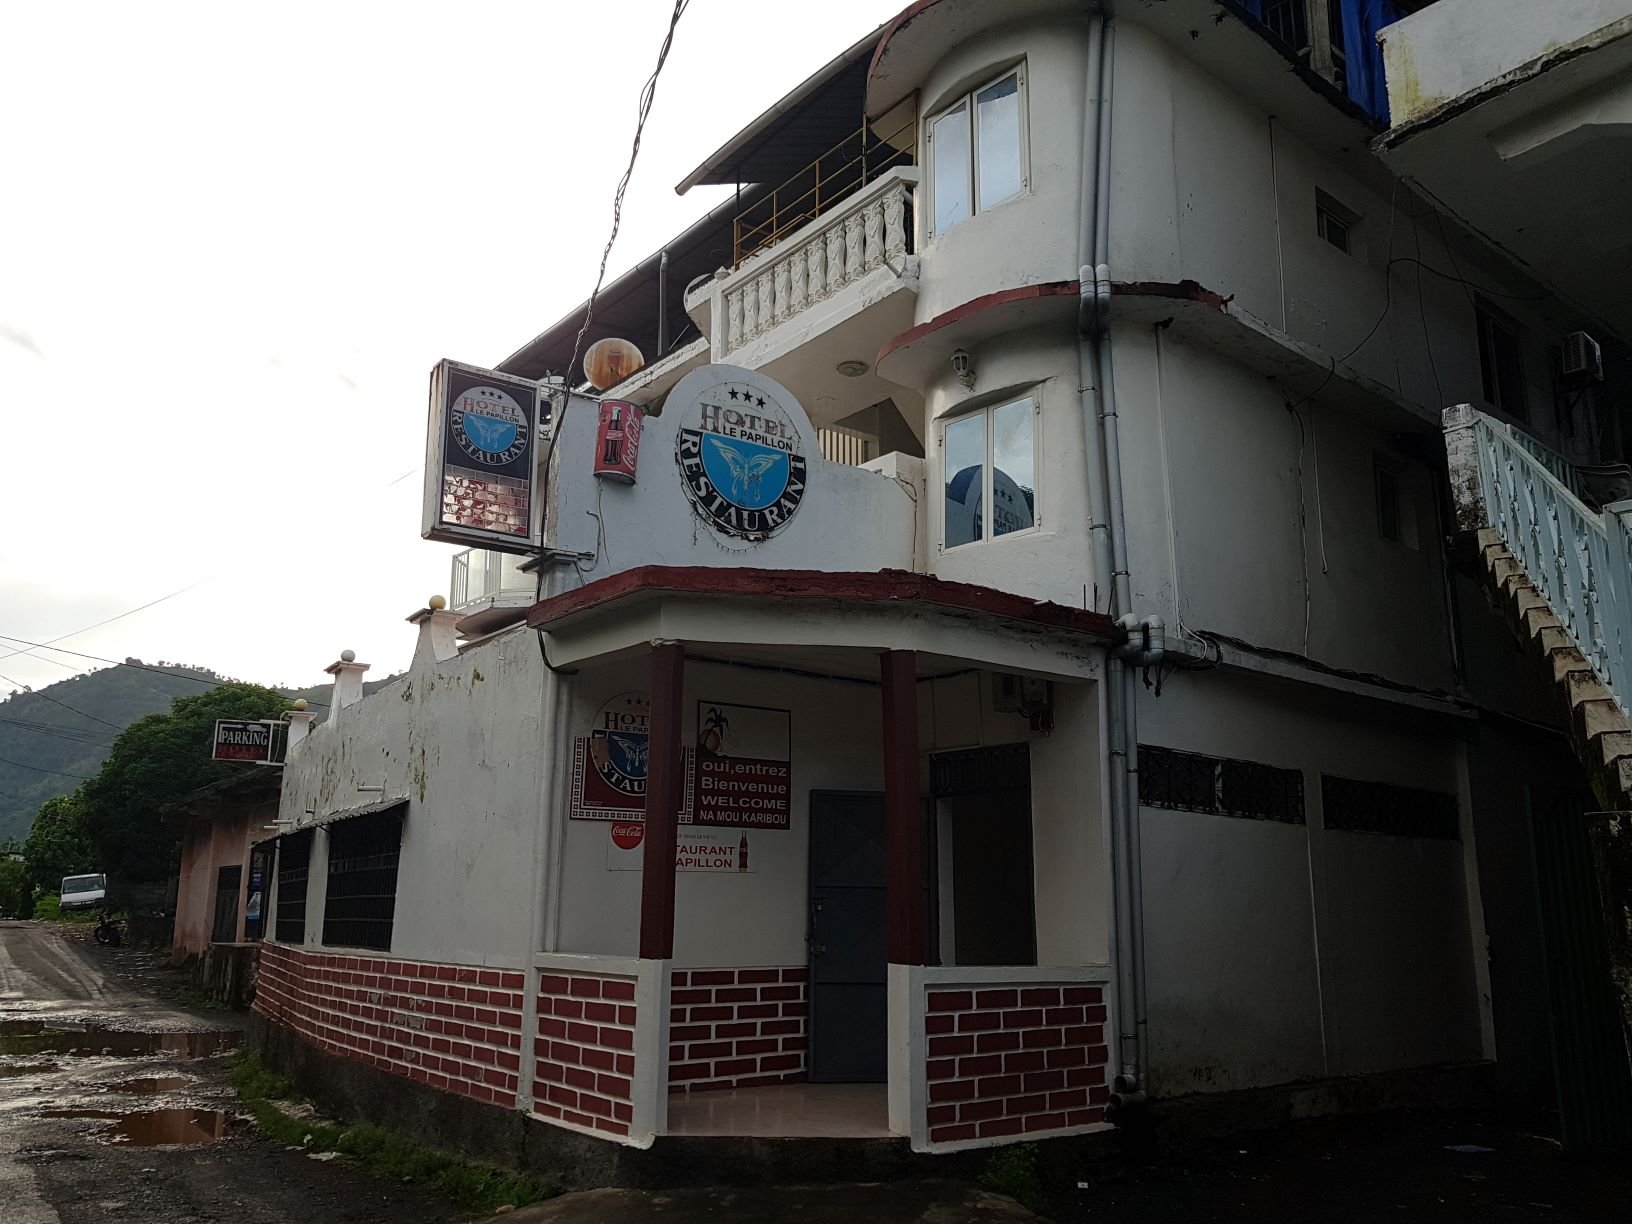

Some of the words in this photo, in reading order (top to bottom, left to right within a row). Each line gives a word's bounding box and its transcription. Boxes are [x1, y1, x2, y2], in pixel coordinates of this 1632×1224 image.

[462, 397, 520, 418] HOTEL
[486, 412, 520, 424] PAPILLON
[698, 402, 793, 440] HOTEL
[452, 409, 528, 465] RESTAURANT
[723, 425, 737, 438] LE
[740, 429, 793, 452] PAPILLON
[680, 428, 806, 531] RESTAURANT
[604, 711, 649, 730] HOT
[222, 730, 268, 745] PARKING
[701, 776, 788, 795] Bienvenue
[701, 794, 788, 810] WELCOME
[699, 809, 715, 821] NA
[716, 811, 740, 822] MOU
[742, 812, 787, 825] KARIBOU
[675, 857, 733, 868] APILLON
